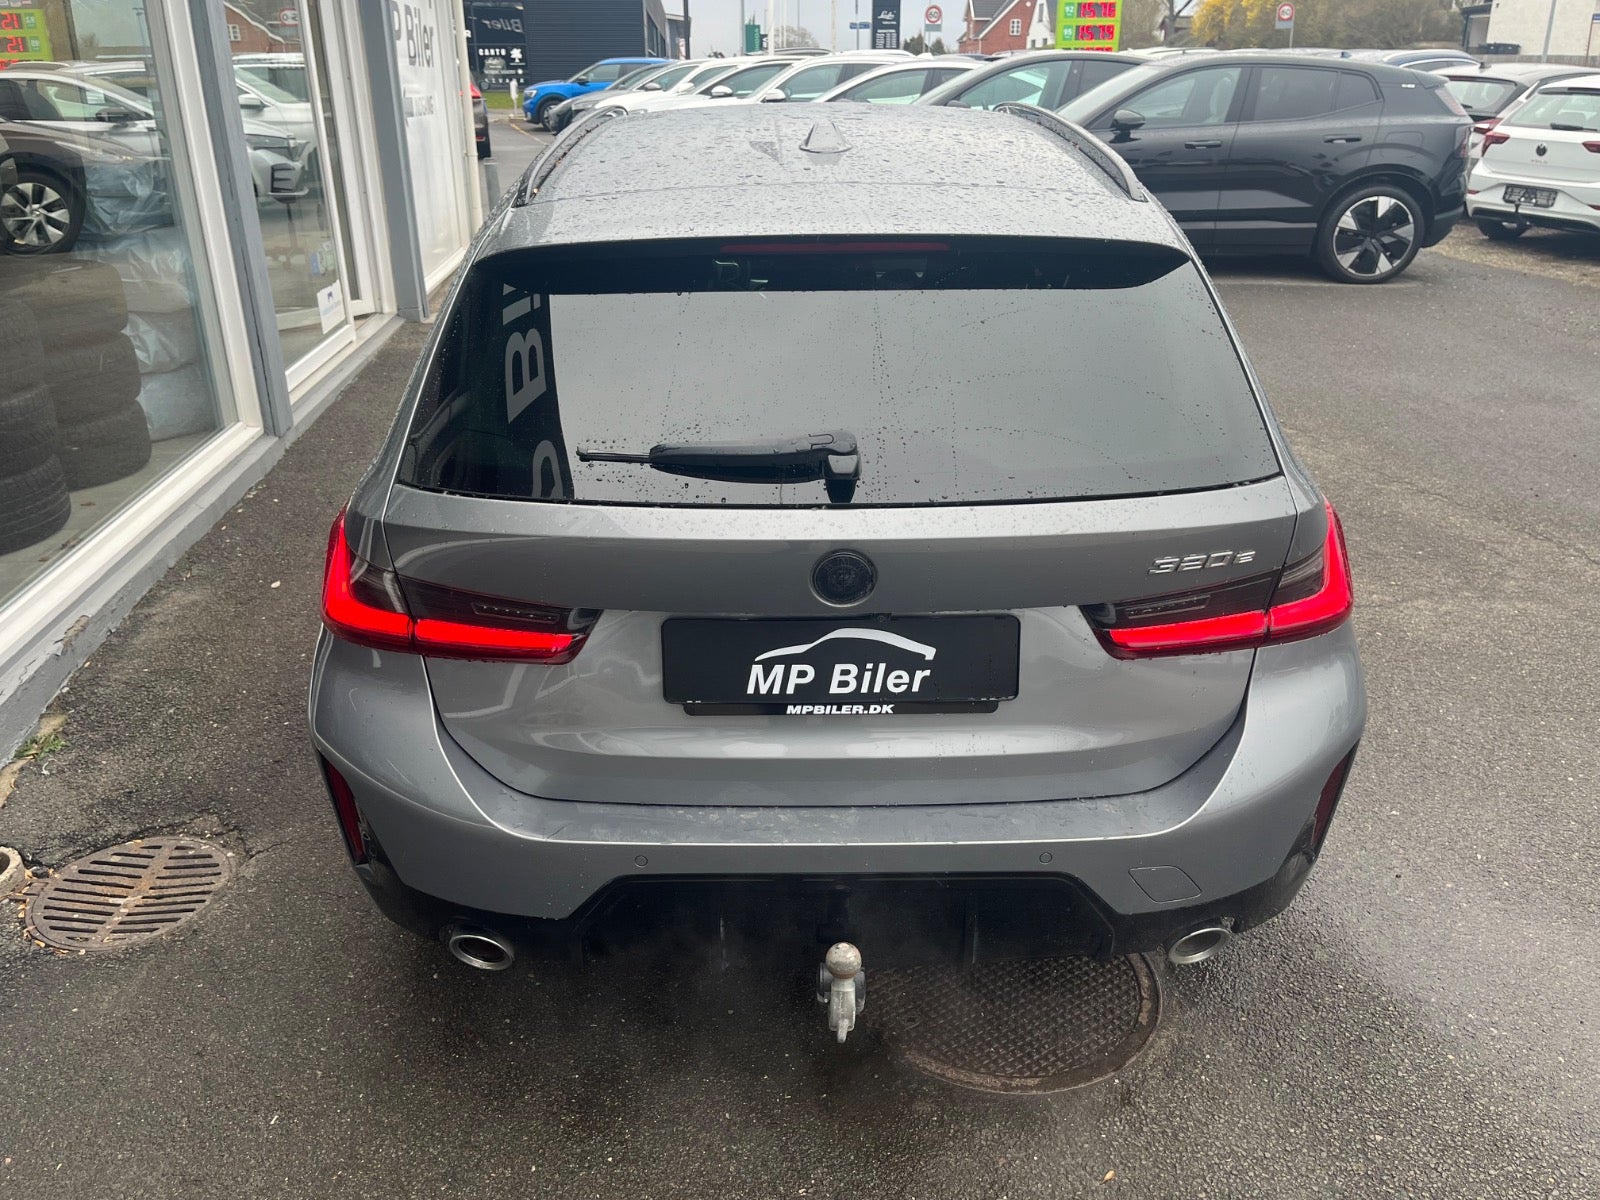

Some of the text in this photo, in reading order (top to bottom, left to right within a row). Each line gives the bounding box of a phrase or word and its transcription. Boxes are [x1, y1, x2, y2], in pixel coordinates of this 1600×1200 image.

[404, 4, 434, 68] Biler
[746, 662, 932, 695] MP Biler
[786, 703, 895, 715] MPBILER.DK
